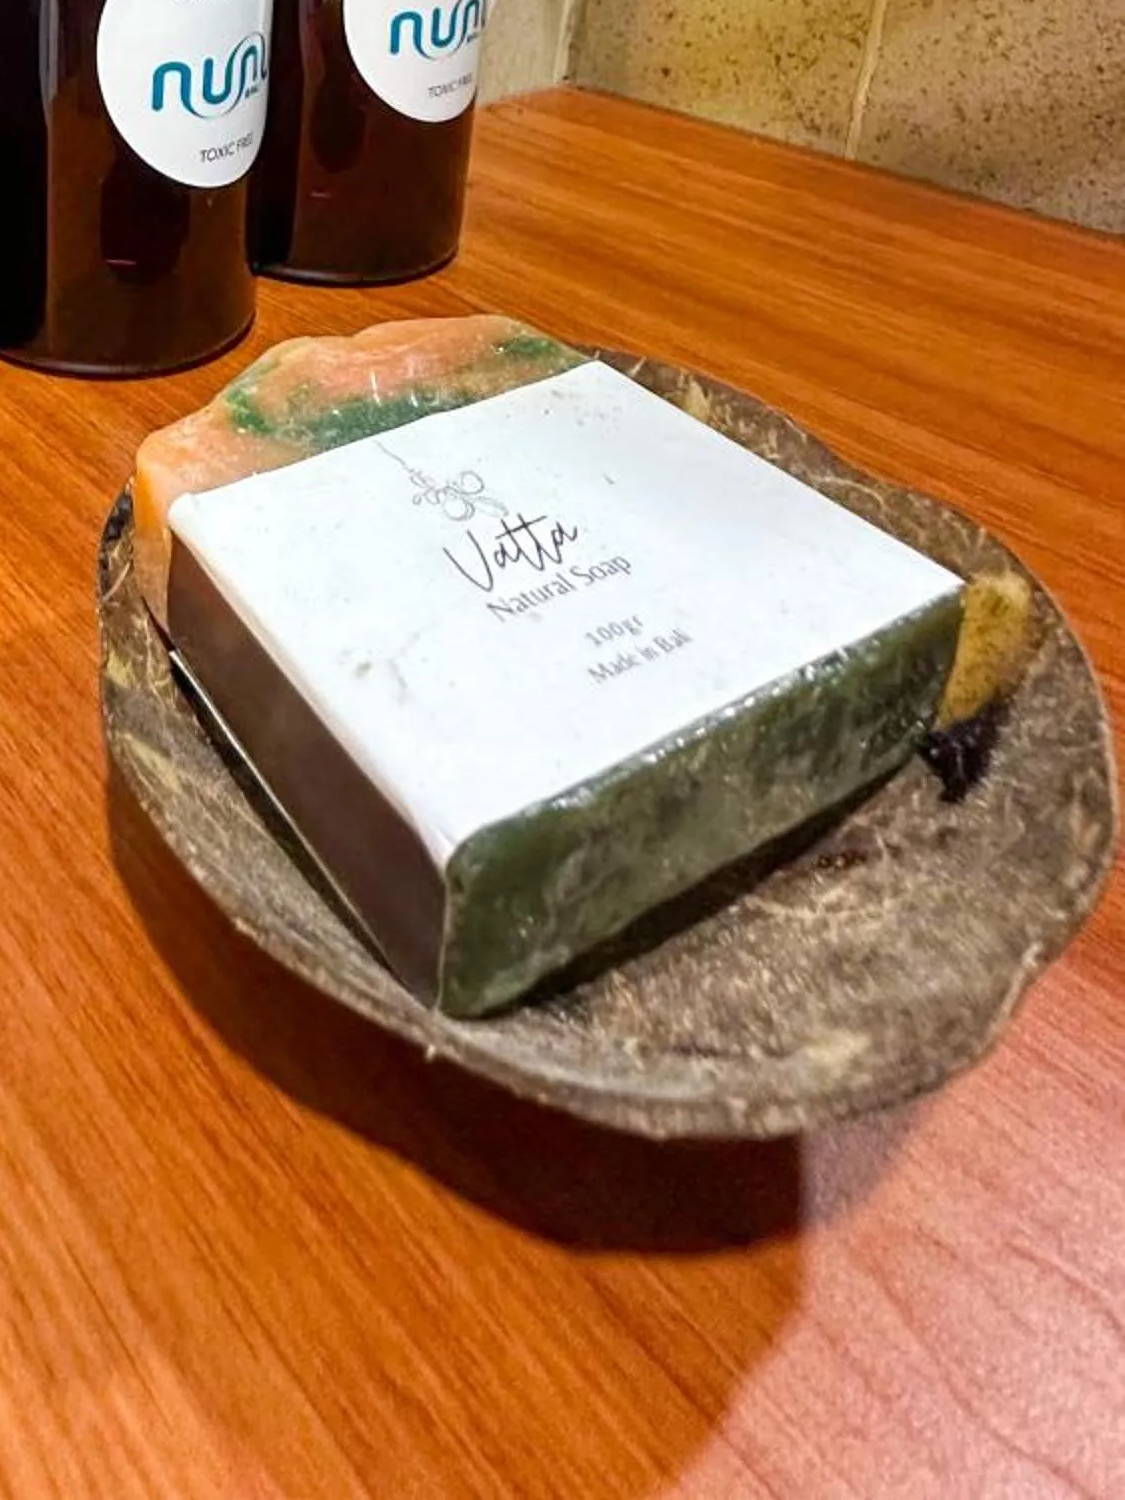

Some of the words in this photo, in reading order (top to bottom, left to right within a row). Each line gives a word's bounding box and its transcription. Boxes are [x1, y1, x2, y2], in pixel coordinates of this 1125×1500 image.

[485, 572, 579, 624] Natural
[570, 554, 633, 588] Soap
[587, 654, 641, 685] Made
